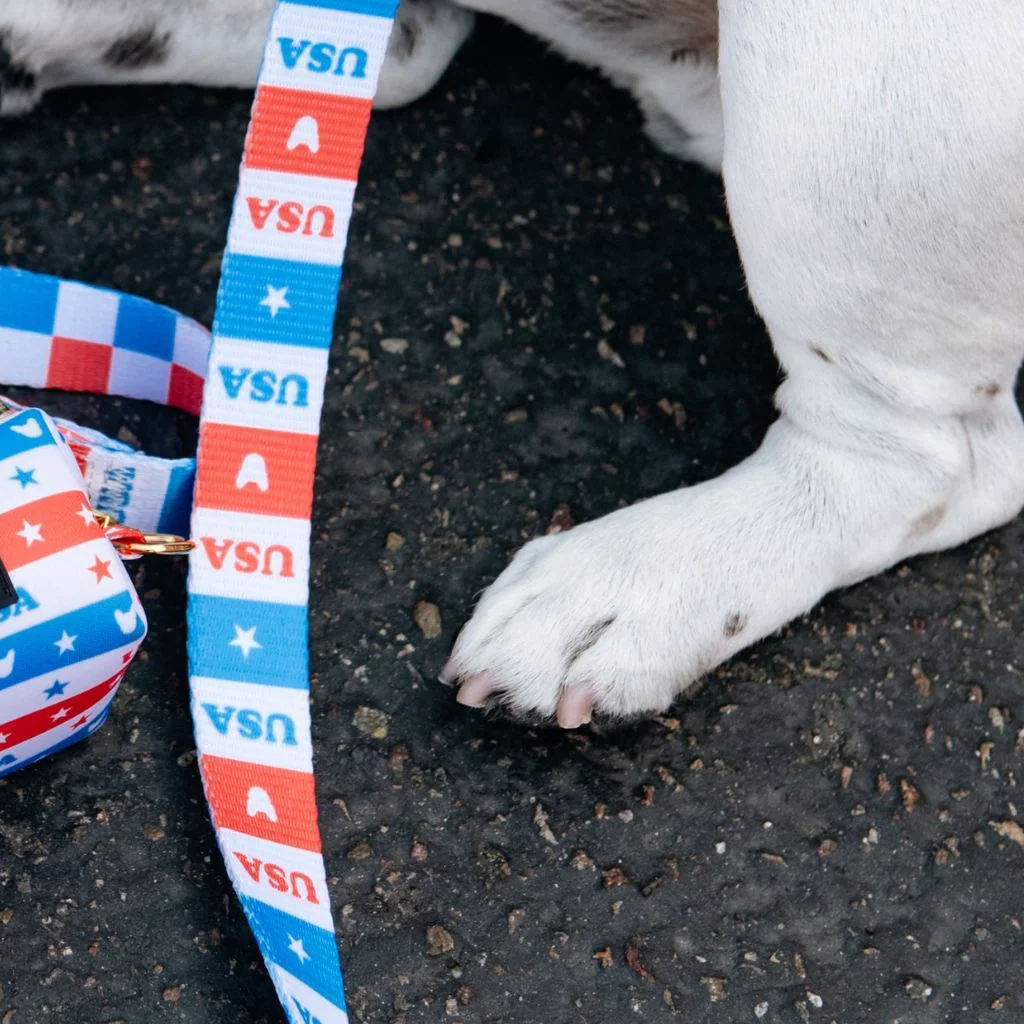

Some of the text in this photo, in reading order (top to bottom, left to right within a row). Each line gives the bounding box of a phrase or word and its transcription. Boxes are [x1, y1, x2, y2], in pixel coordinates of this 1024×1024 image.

[276, 36, 368, 78] USA
[245, 197, 335, 237] USA
[218, 365, 308, 407] USA
[200, 537, 295, 577] USA
[201, 702, 298, 746] USA
[232, 851, 319, 904] USA
